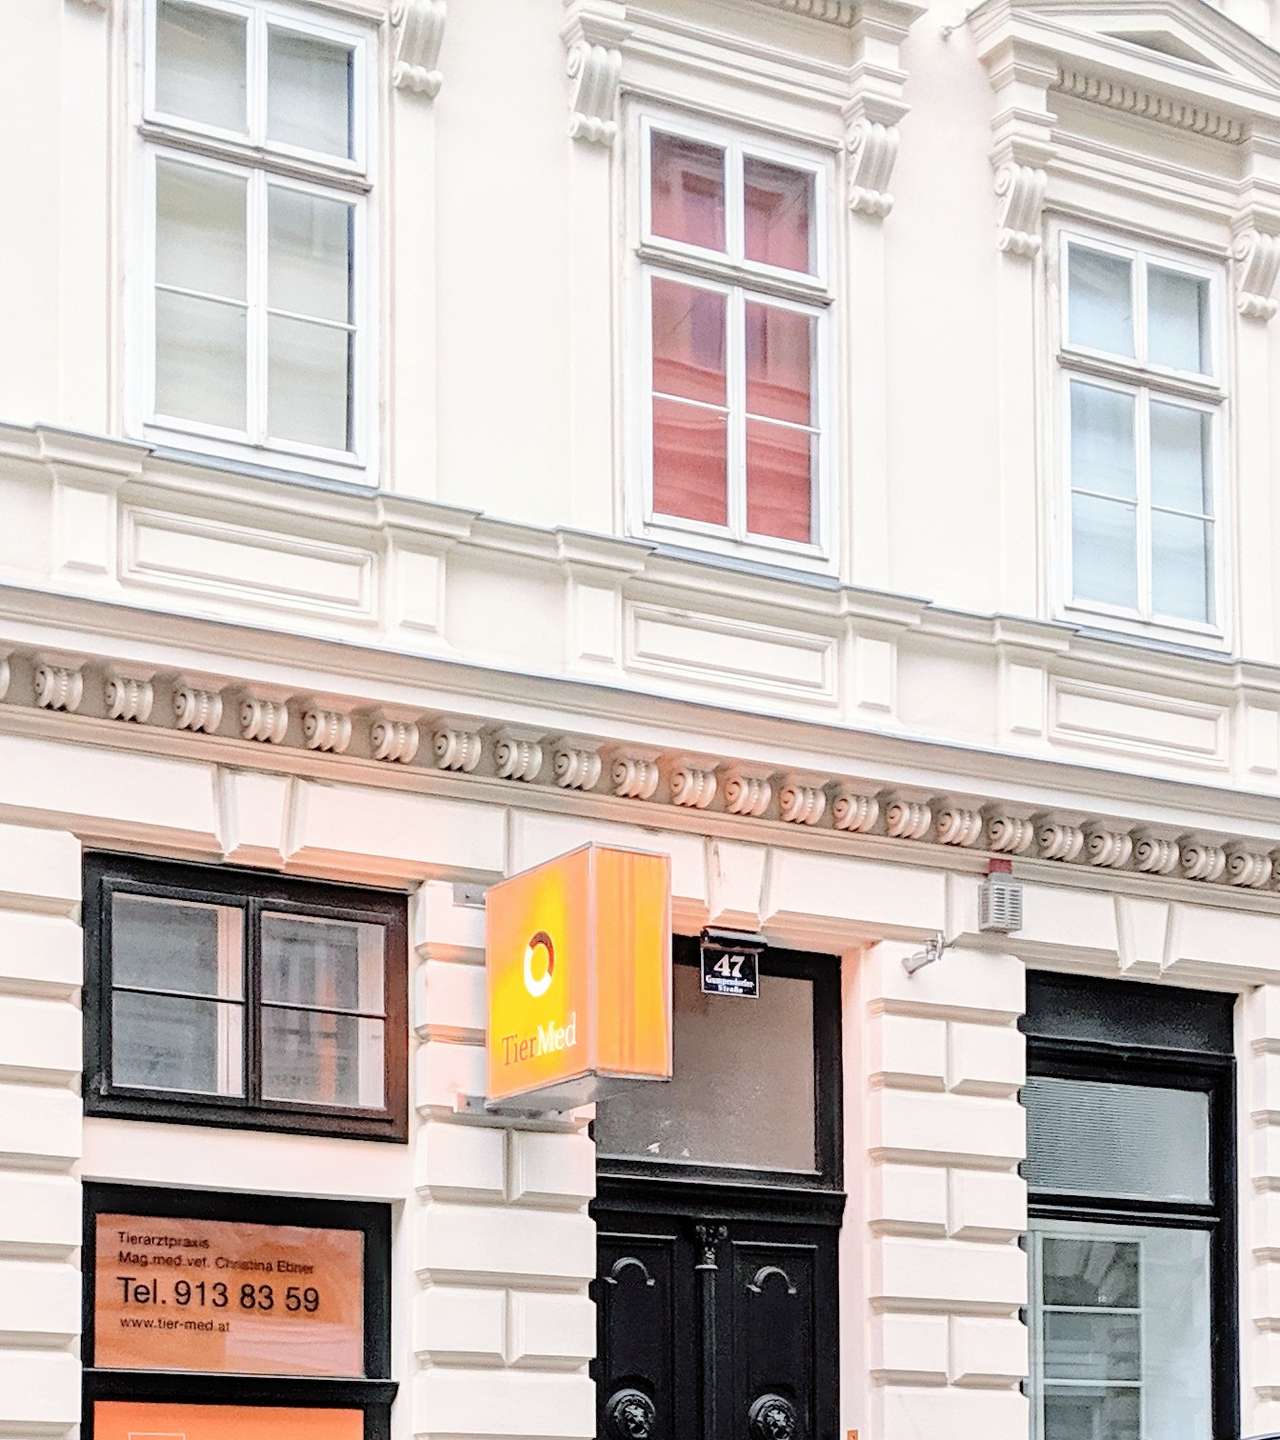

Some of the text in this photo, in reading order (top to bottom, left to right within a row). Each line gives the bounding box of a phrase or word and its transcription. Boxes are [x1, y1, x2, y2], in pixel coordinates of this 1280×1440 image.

[713, 954, 745, 978] 47
[501, 1011, 577, 1066] TierMed
[117, 1231, 210, 1249] Tierarztpraxis
[116, 1276, 321, 1314] Tel. 913 83 59
[119, 1316, 231, 1333] www.tier-med.at
